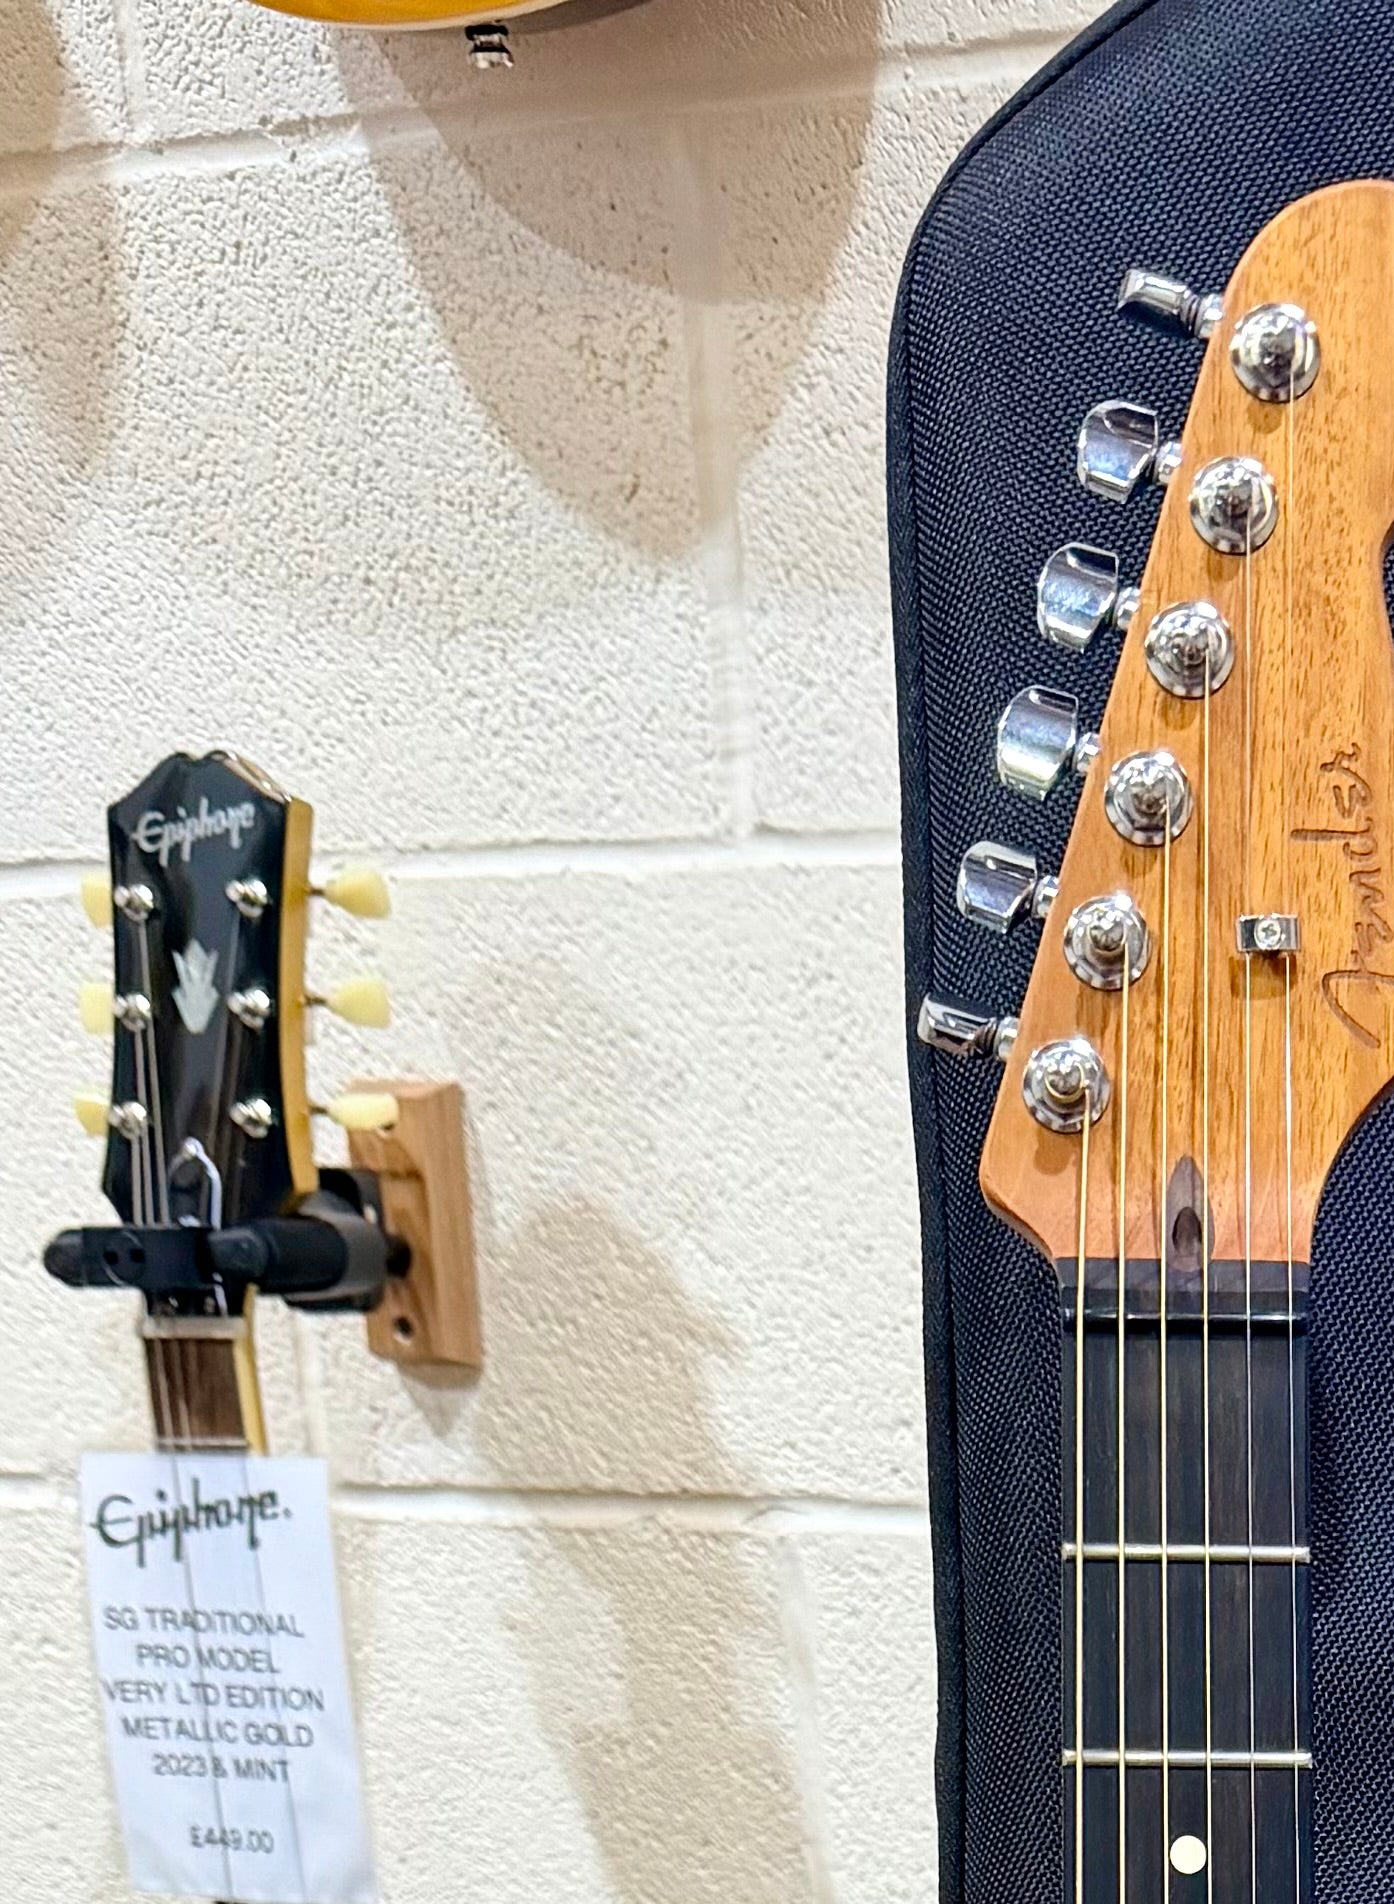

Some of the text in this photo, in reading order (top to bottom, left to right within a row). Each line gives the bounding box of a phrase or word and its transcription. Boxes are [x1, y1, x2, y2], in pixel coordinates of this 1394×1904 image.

[130, 796, 256, 868] Epiphone
[103, 1606, 304, 1639] SG TRADITIONAL
[136, 1643, 281, 1675] PRO MODEL
[101, 1676, 325, 1712] VERY LTD EDITION
[121, 1714, 314, 1747] METALLIC GOLD
[153, 1752, 289, 1783] 2023 & MINT
[189, 1823, 275, 1854] £449.00
